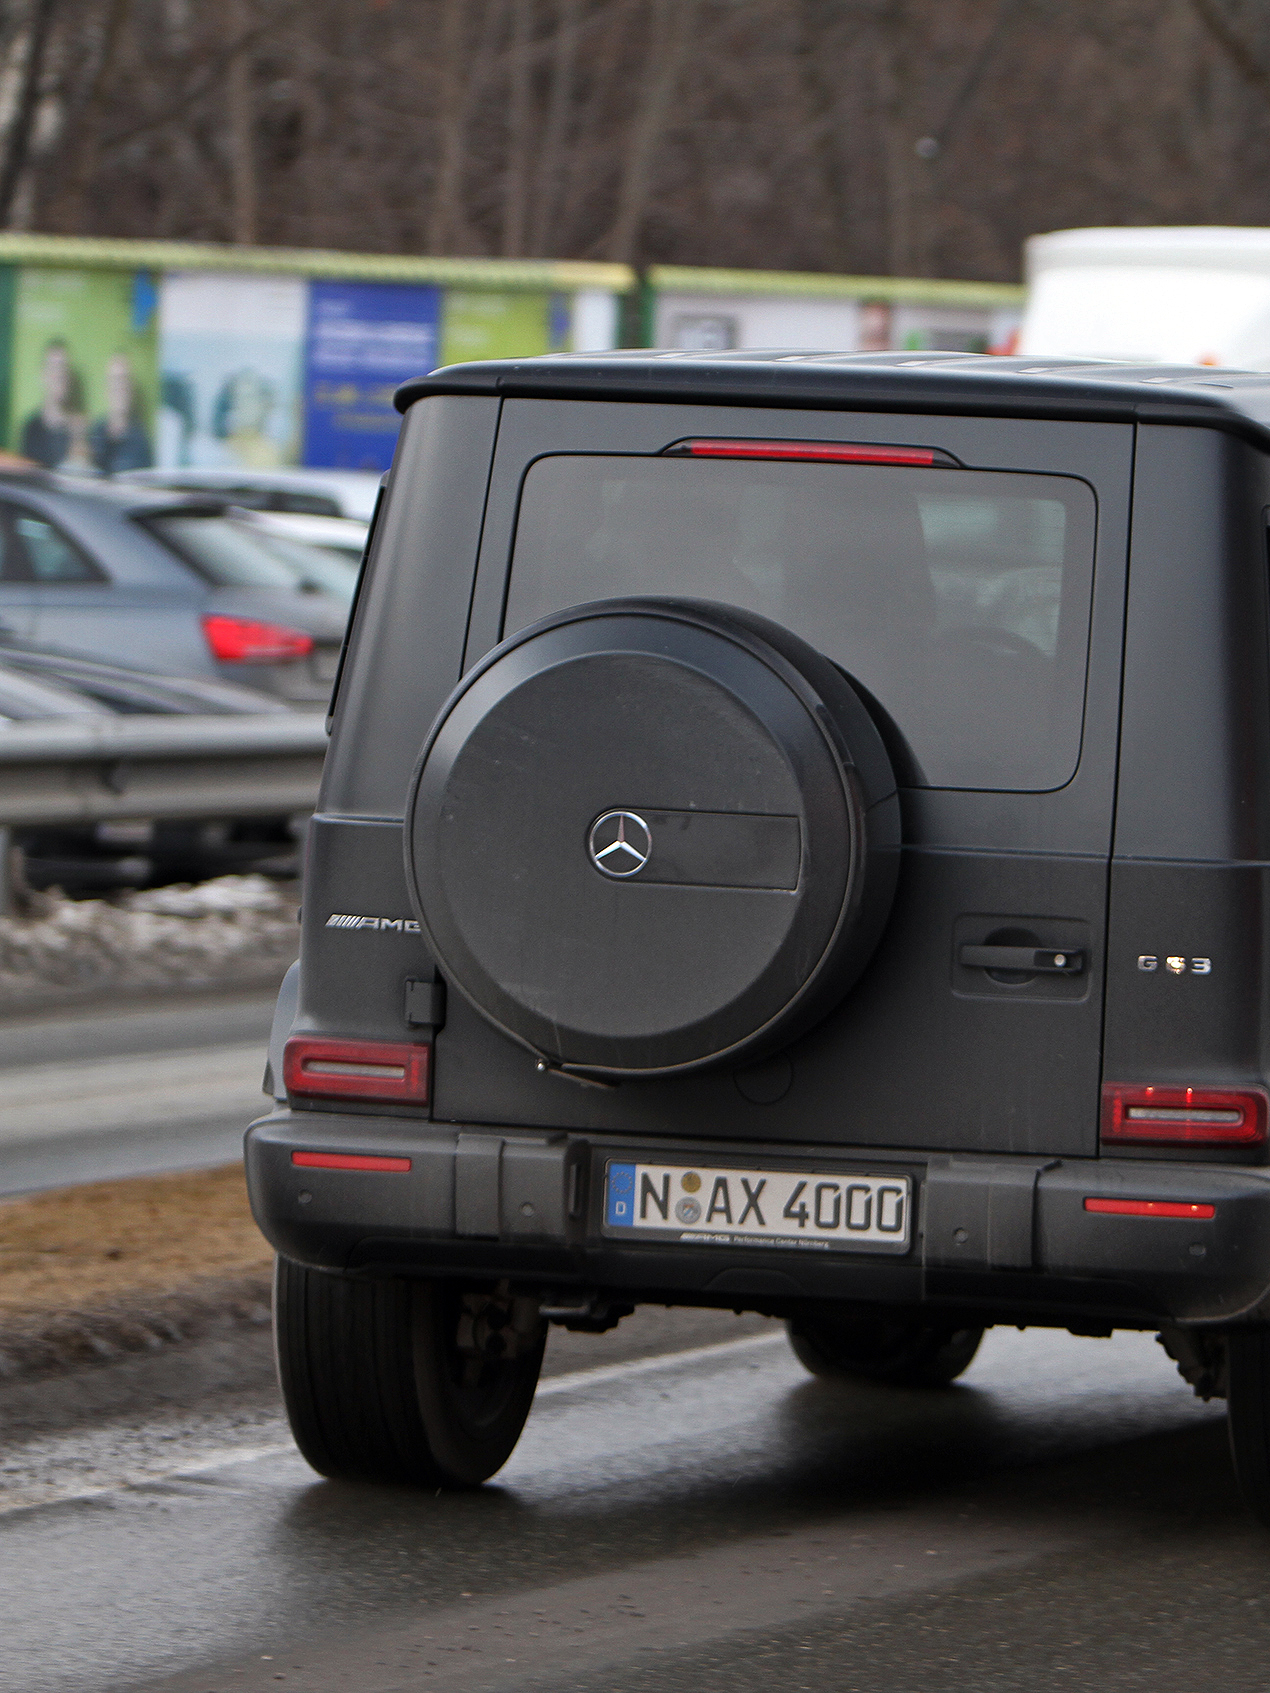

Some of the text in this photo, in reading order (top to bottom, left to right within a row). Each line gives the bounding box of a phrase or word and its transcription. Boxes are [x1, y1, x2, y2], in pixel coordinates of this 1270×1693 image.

[615, 1201, 626, 1216] D
[640, 1172, 905, 1232] N AX 4000
